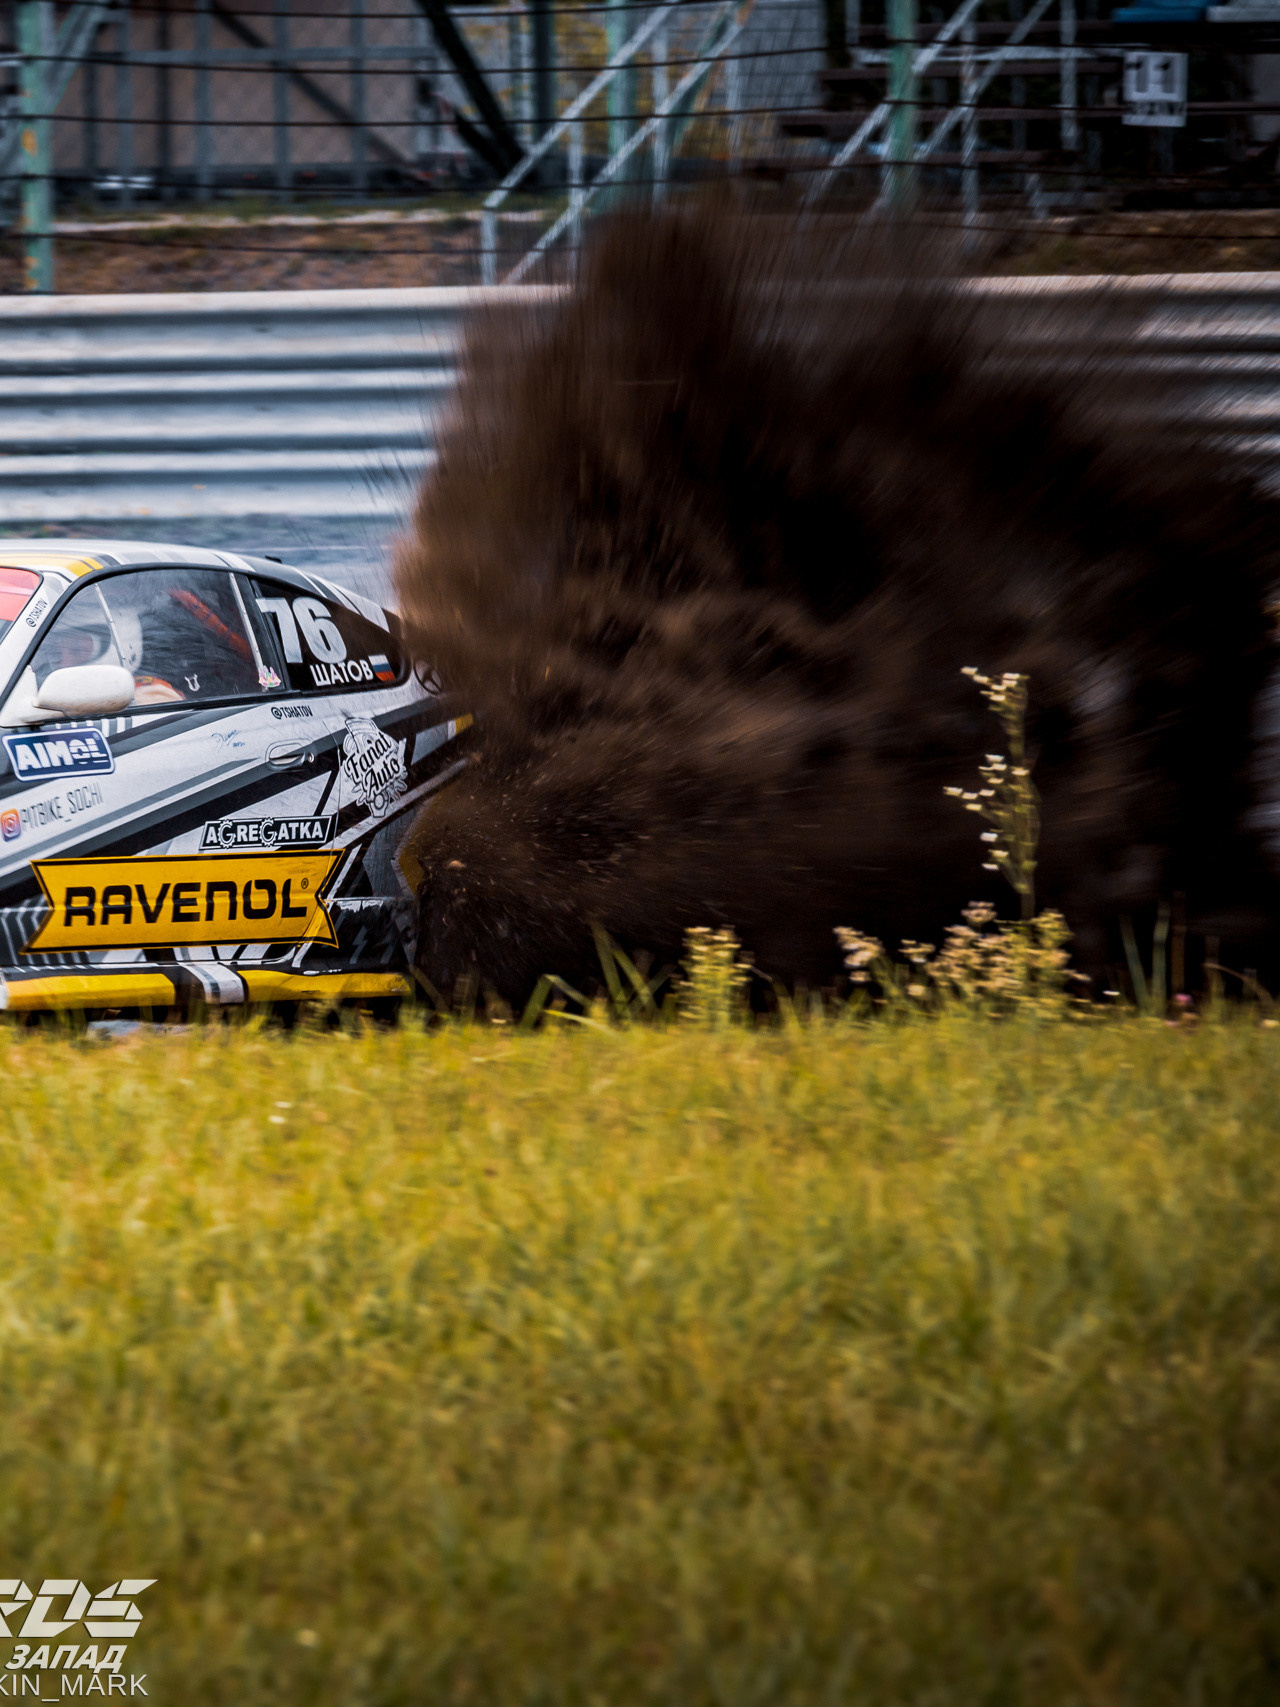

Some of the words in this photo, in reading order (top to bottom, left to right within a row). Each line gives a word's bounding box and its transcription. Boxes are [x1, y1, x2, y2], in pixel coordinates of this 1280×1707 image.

[256, 596, 347, 664] 76
[310, 659, 374, 686] ШАТОВ
[271, 705, 313, 719] @TSHATOV
[14, 736, 108, 771] AIMOL
[365, 754, 400, 797] Auto
[20, 782, 104, 832] PITBIKE_SOCHI
[205, 819, 323, 846] AGREGATKA
[63, 878, 308, 927] RAVENOL
